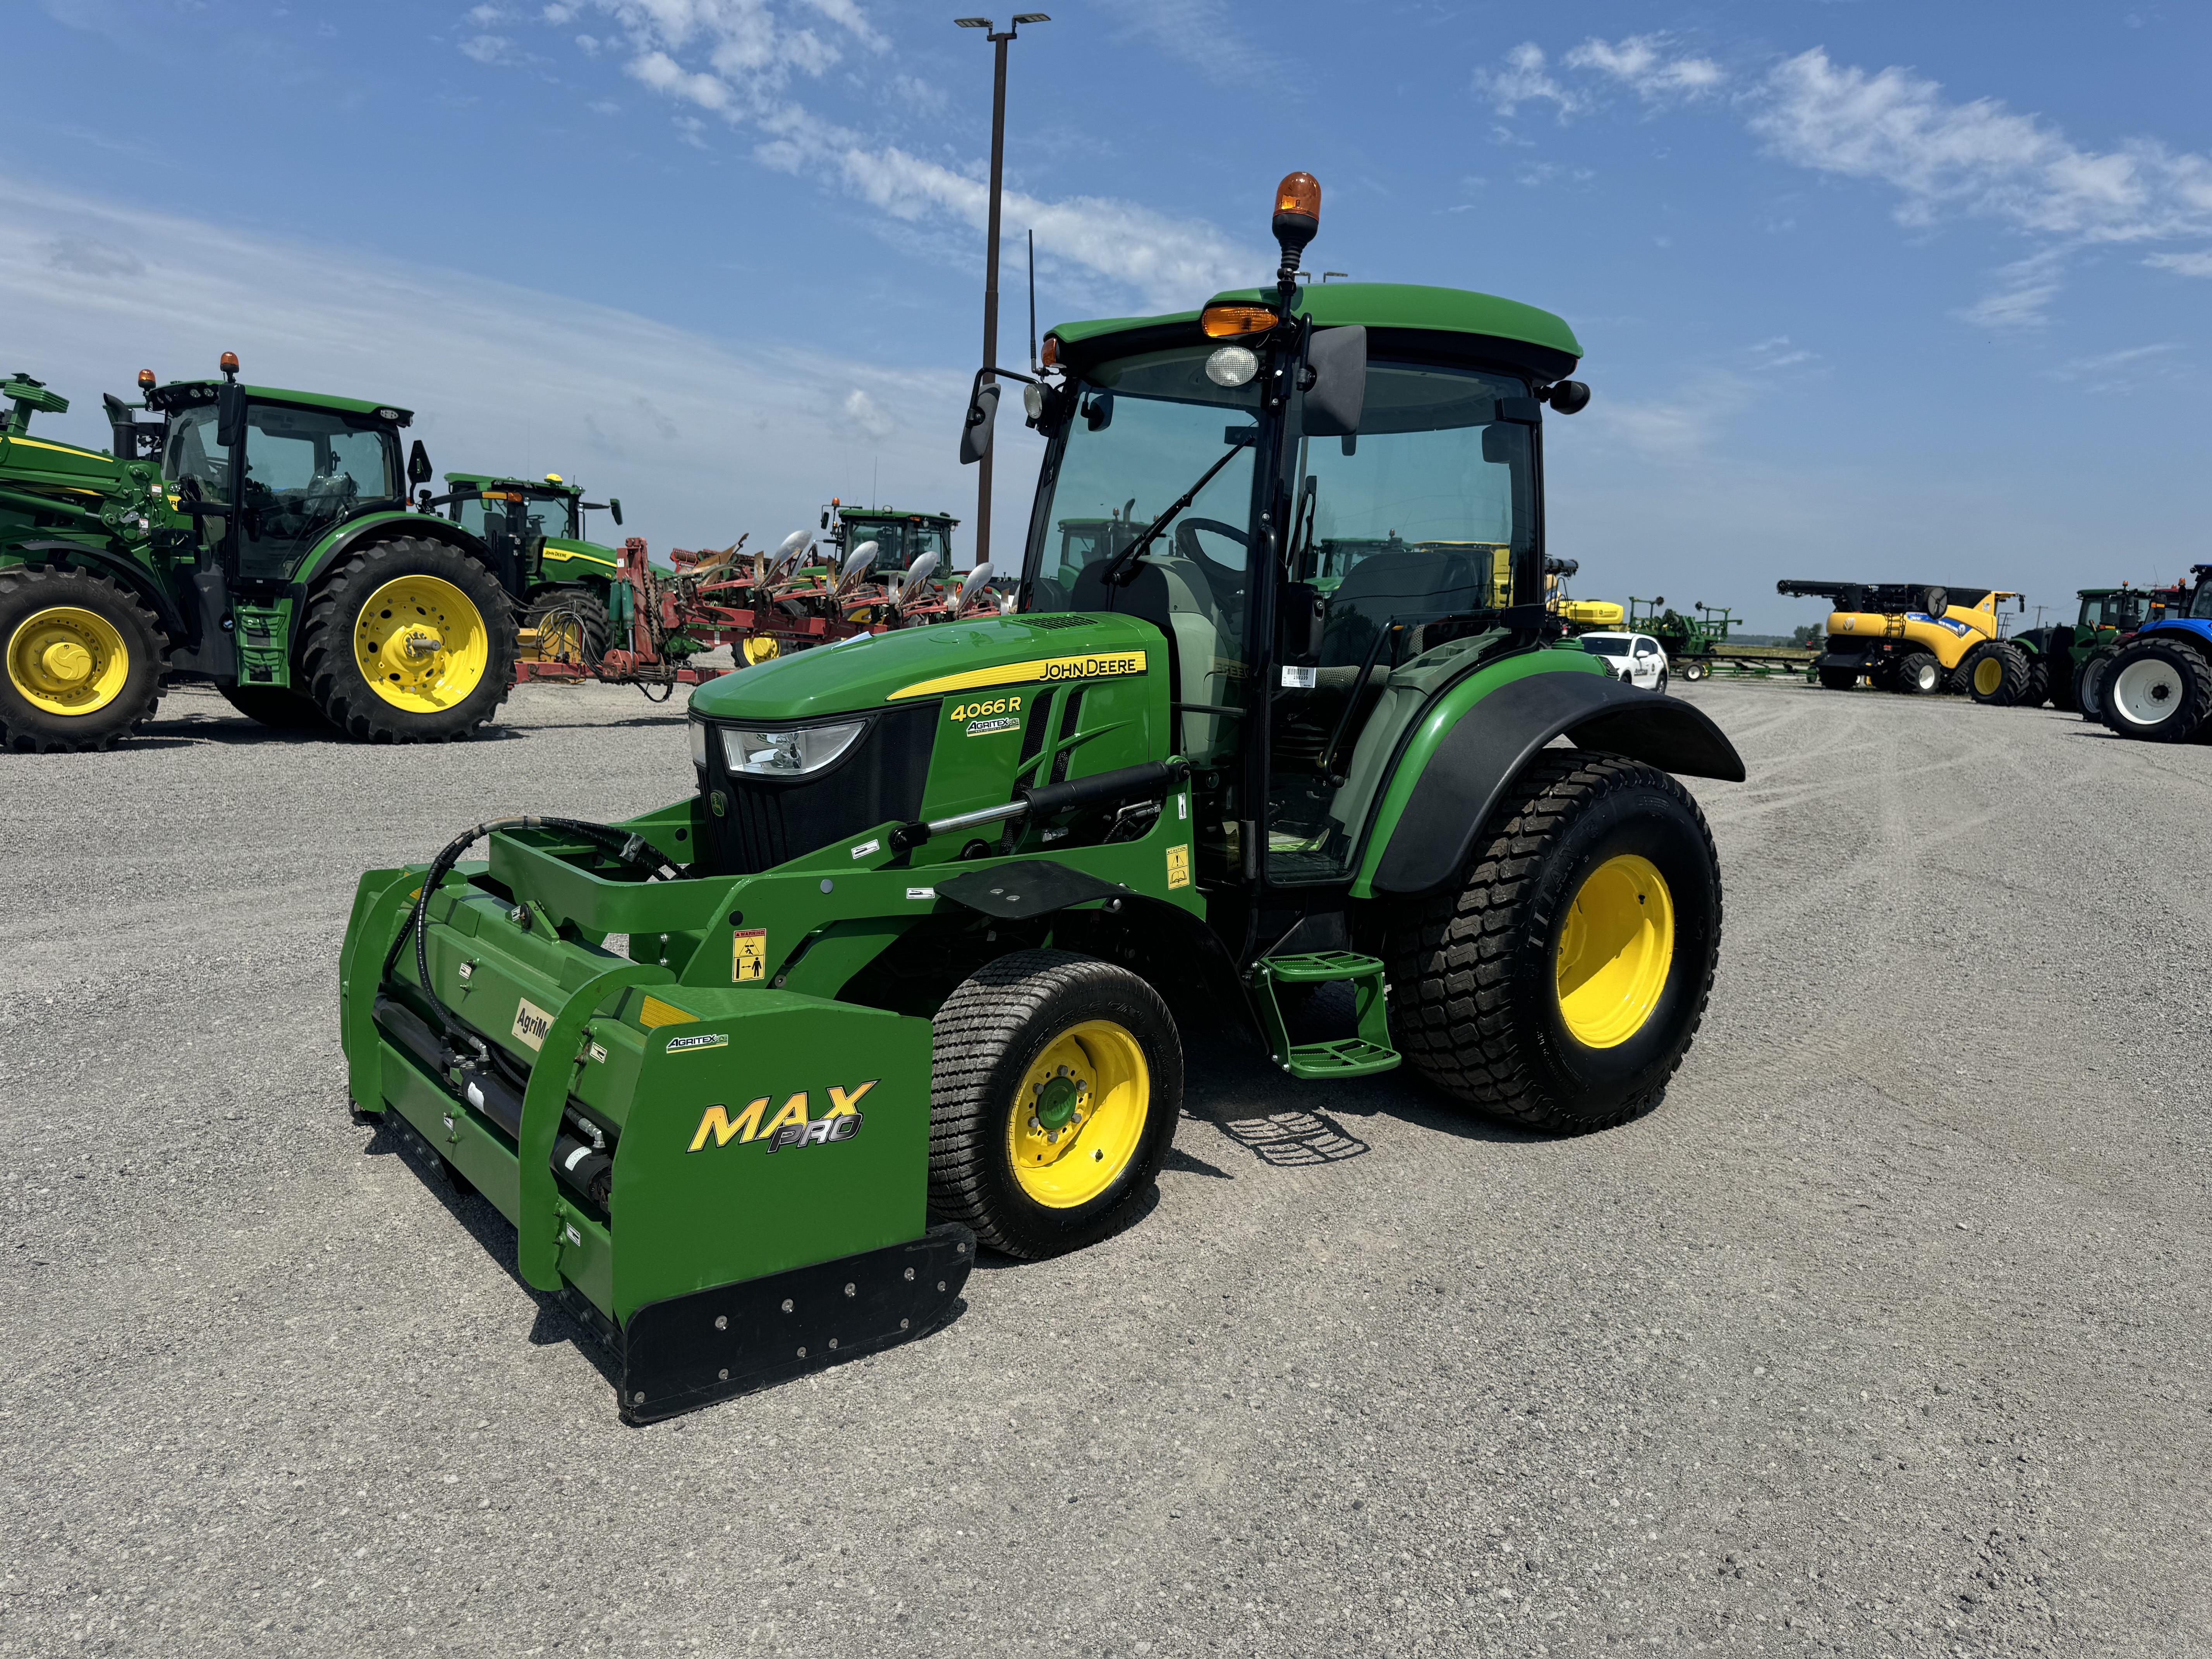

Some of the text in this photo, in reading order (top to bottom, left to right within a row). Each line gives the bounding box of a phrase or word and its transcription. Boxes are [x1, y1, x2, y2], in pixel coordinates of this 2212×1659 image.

[1040, 659, 1136, 679] JOHN DEERE
[950, 697, 1022, 722] 4066 R
[968, 719, 1008, 730] AGRITEX
[517, 1008, 549, 1039] AgriM
[668, 1035, 716, 1047] AGRITEX
[685, 1079, 881, 1153] MAX
[766, 1113, 864, 1154] PRO
